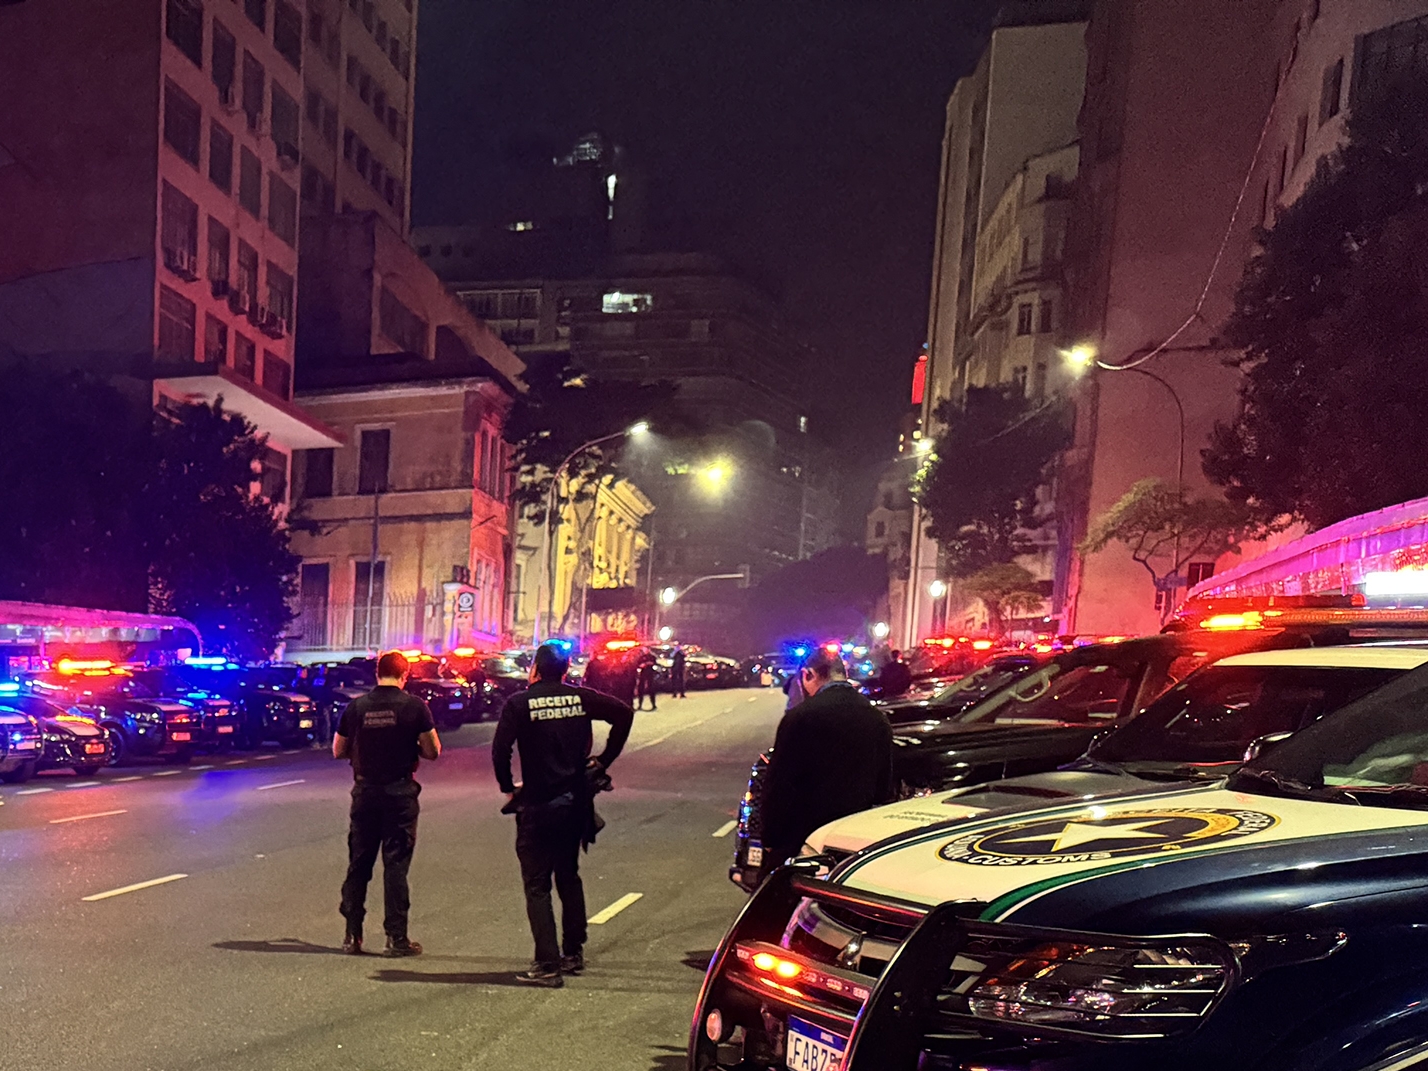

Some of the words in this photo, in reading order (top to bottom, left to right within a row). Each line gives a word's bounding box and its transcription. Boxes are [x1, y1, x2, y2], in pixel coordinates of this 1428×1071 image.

[528, 695, 582, 710] RECEITA
[530, 705, 587, 721] FEDERAL
[968, 852, 1112, 866] CUSTOMS
